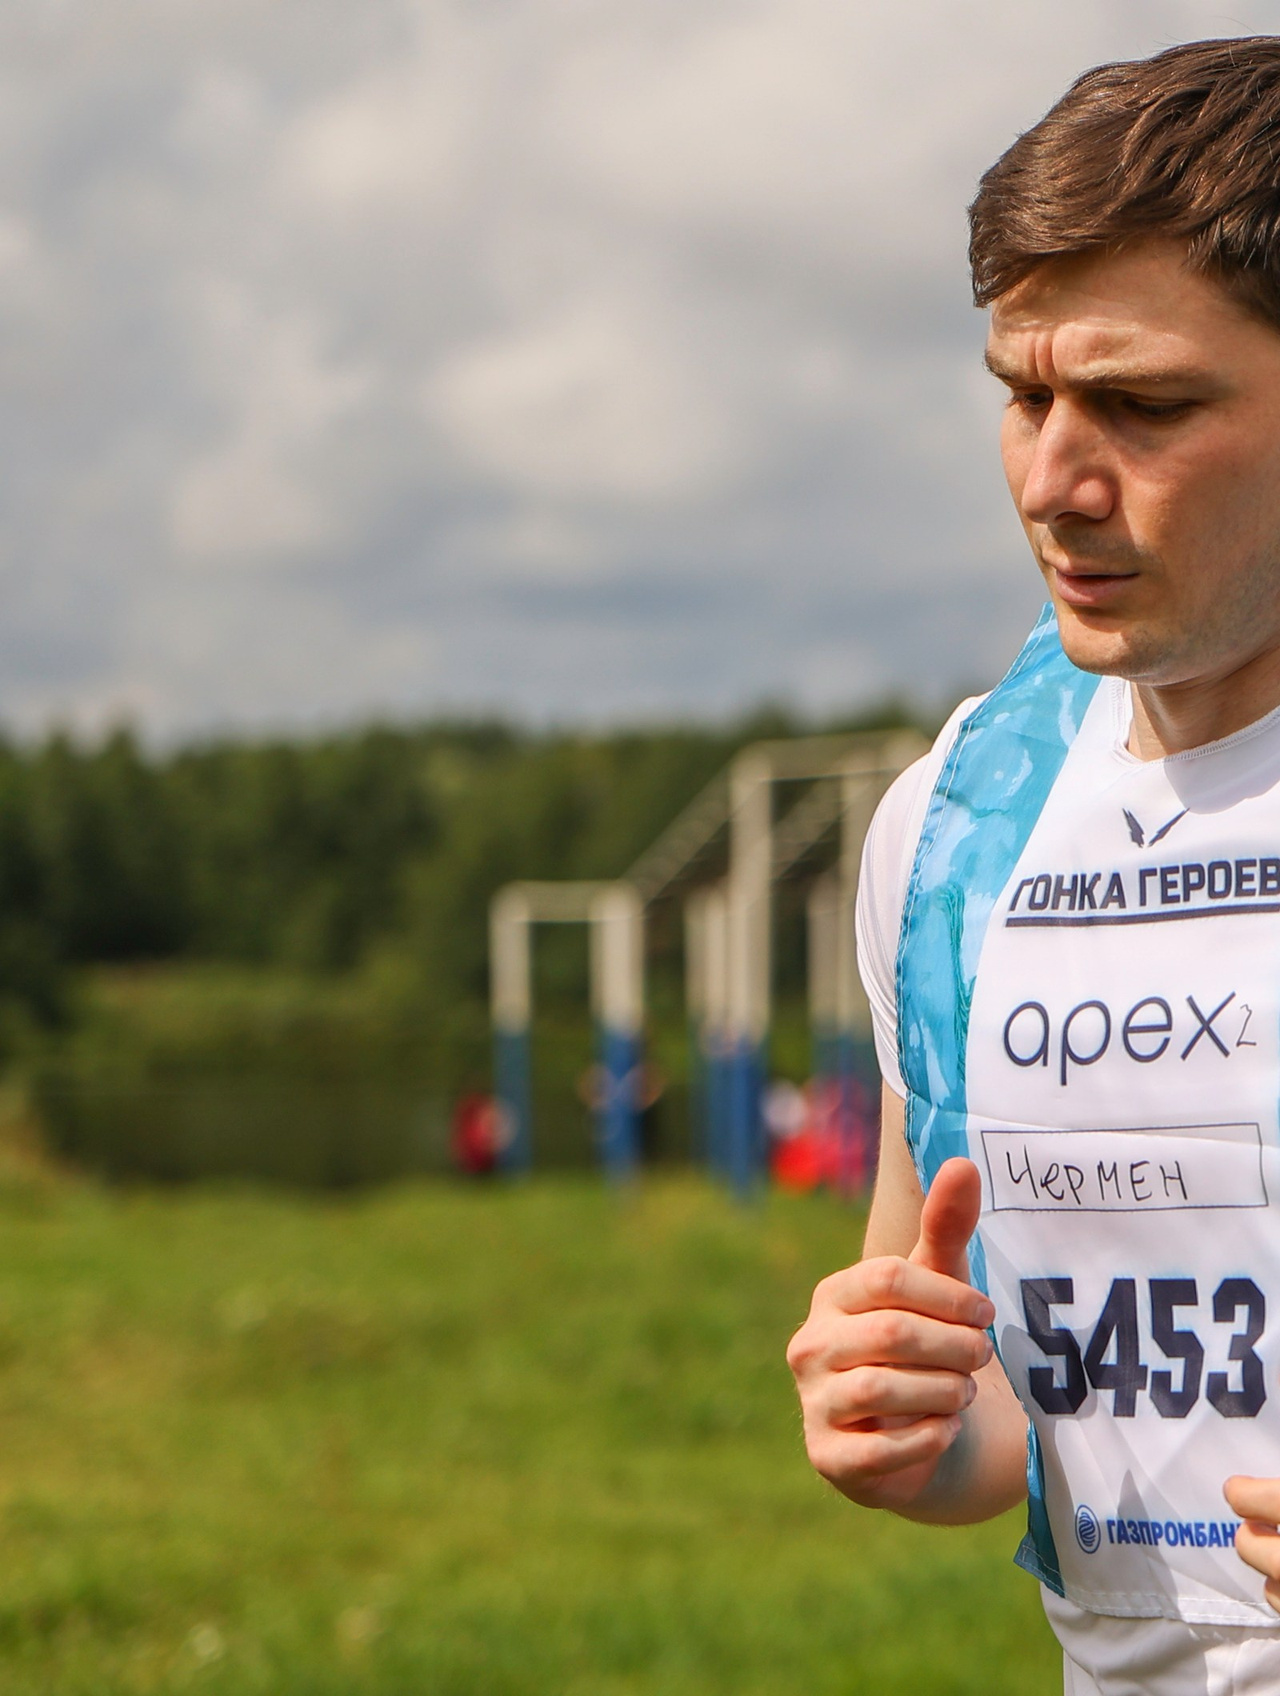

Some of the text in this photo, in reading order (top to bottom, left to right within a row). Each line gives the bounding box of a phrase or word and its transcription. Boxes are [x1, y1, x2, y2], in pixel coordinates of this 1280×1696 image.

[1009, 873, 1126, 911] ГОНКА
[1003, 991, 1236, 1086] apex
[1020, 1278, 1267, 1418] 5453
[1106, 1519, 1240, 1548] ГАЗПРОМБАН
